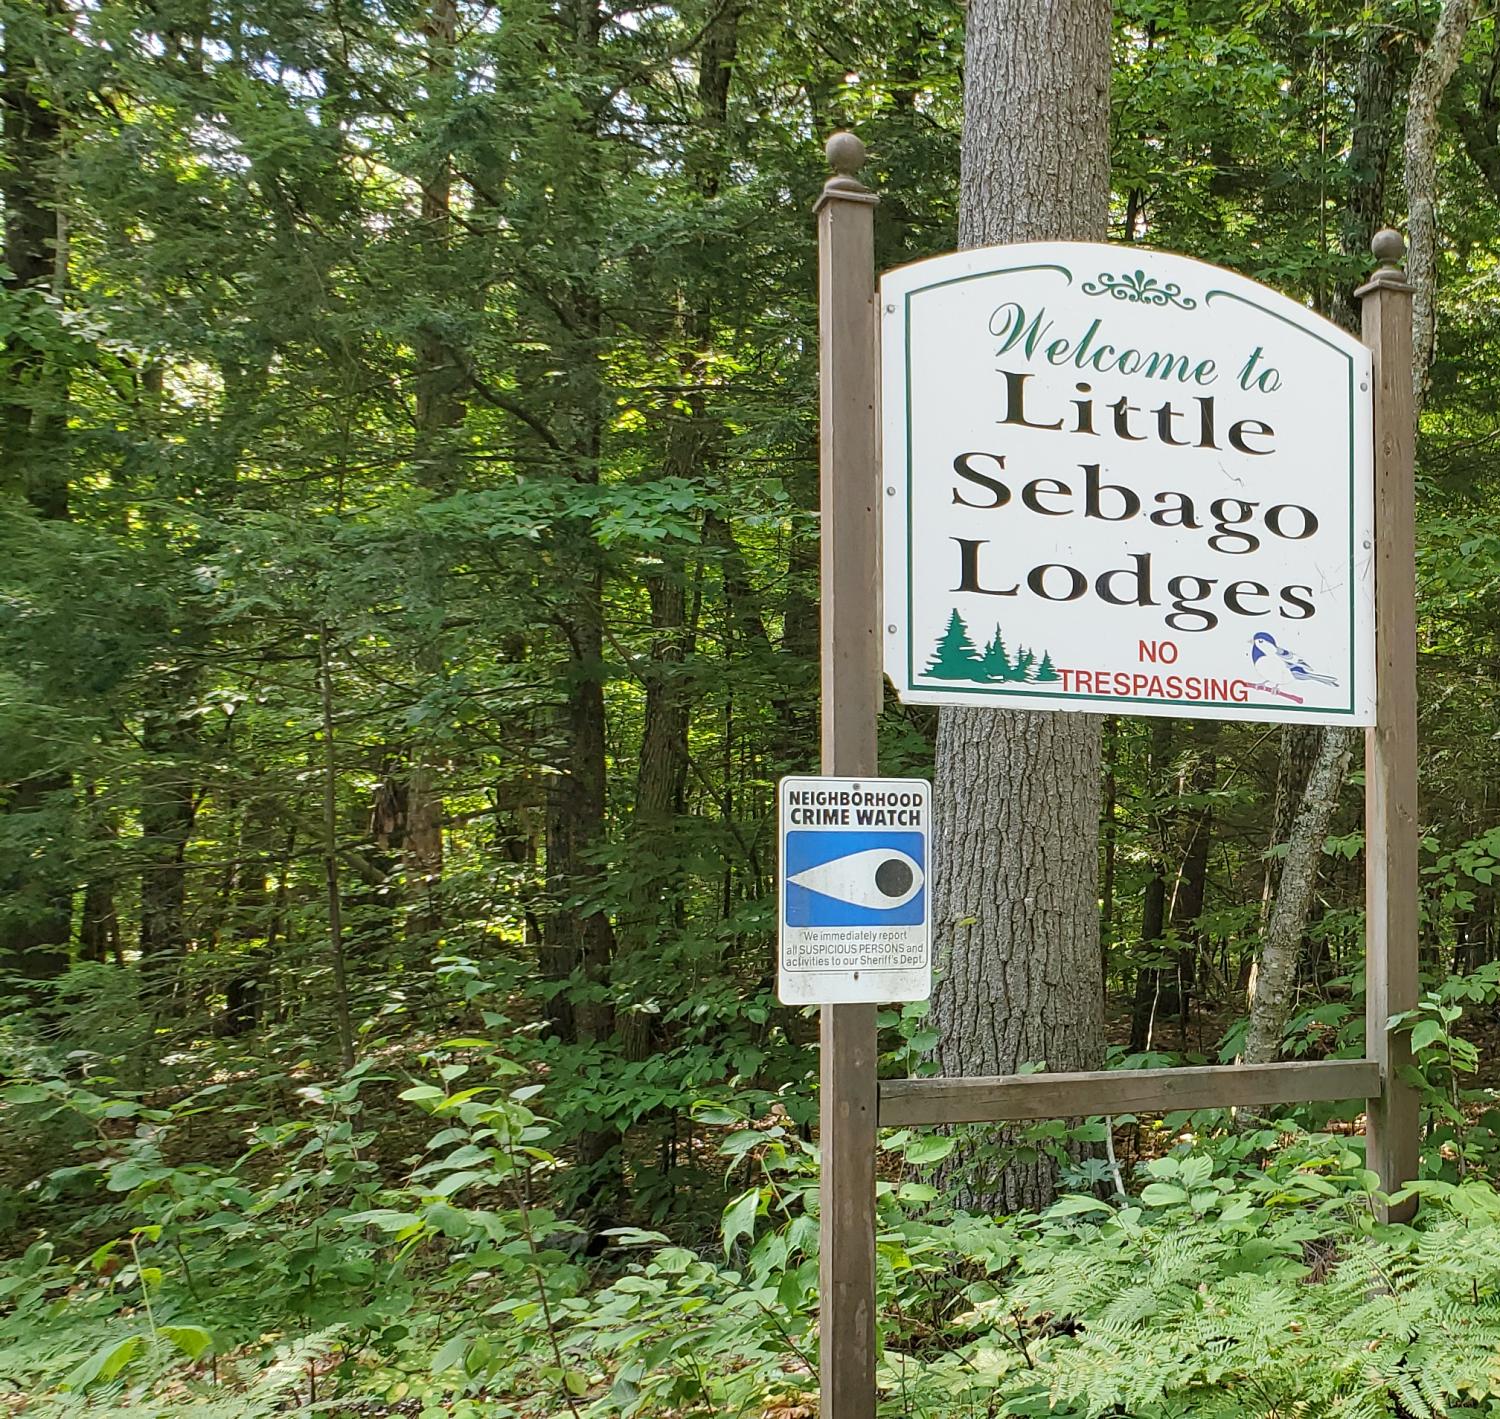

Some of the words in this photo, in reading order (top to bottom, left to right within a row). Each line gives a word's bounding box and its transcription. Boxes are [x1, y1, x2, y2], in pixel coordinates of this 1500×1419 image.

[988, 302, 1219, 385] Welcome
[1237, 347, 1282, 393] to
[995, 369, 1276, 455] Little
[952, 452, 1319, 554] Sebago
[949, 537, 1316, 632] Lodges
[1139, 640, 1178, 664] NO
[1057, 669, 1249, 702] TRESPASSING
[789, 791, 923, 807] NEIGHBORHOOD
[791, 808, 850, 825] CRIME
[857, 810, 921, 826] WATCH
[804, 932, 818, 940] We
[820, 931, 877, 942] immediately
[879, 932, 907, 942] report
[786, 945, 797, 955] all
[800, 944, 857, 954] SUSPICIOUS
[859, 944, 904, 953] PERSONS
[906, 944, 923, 952] and
[786, 956, 829, 967] activities
[832, 956, 840, 966] to
[860, 955, 899, 965] Sheriff's
[901, 955, 924, 965] Dept.
